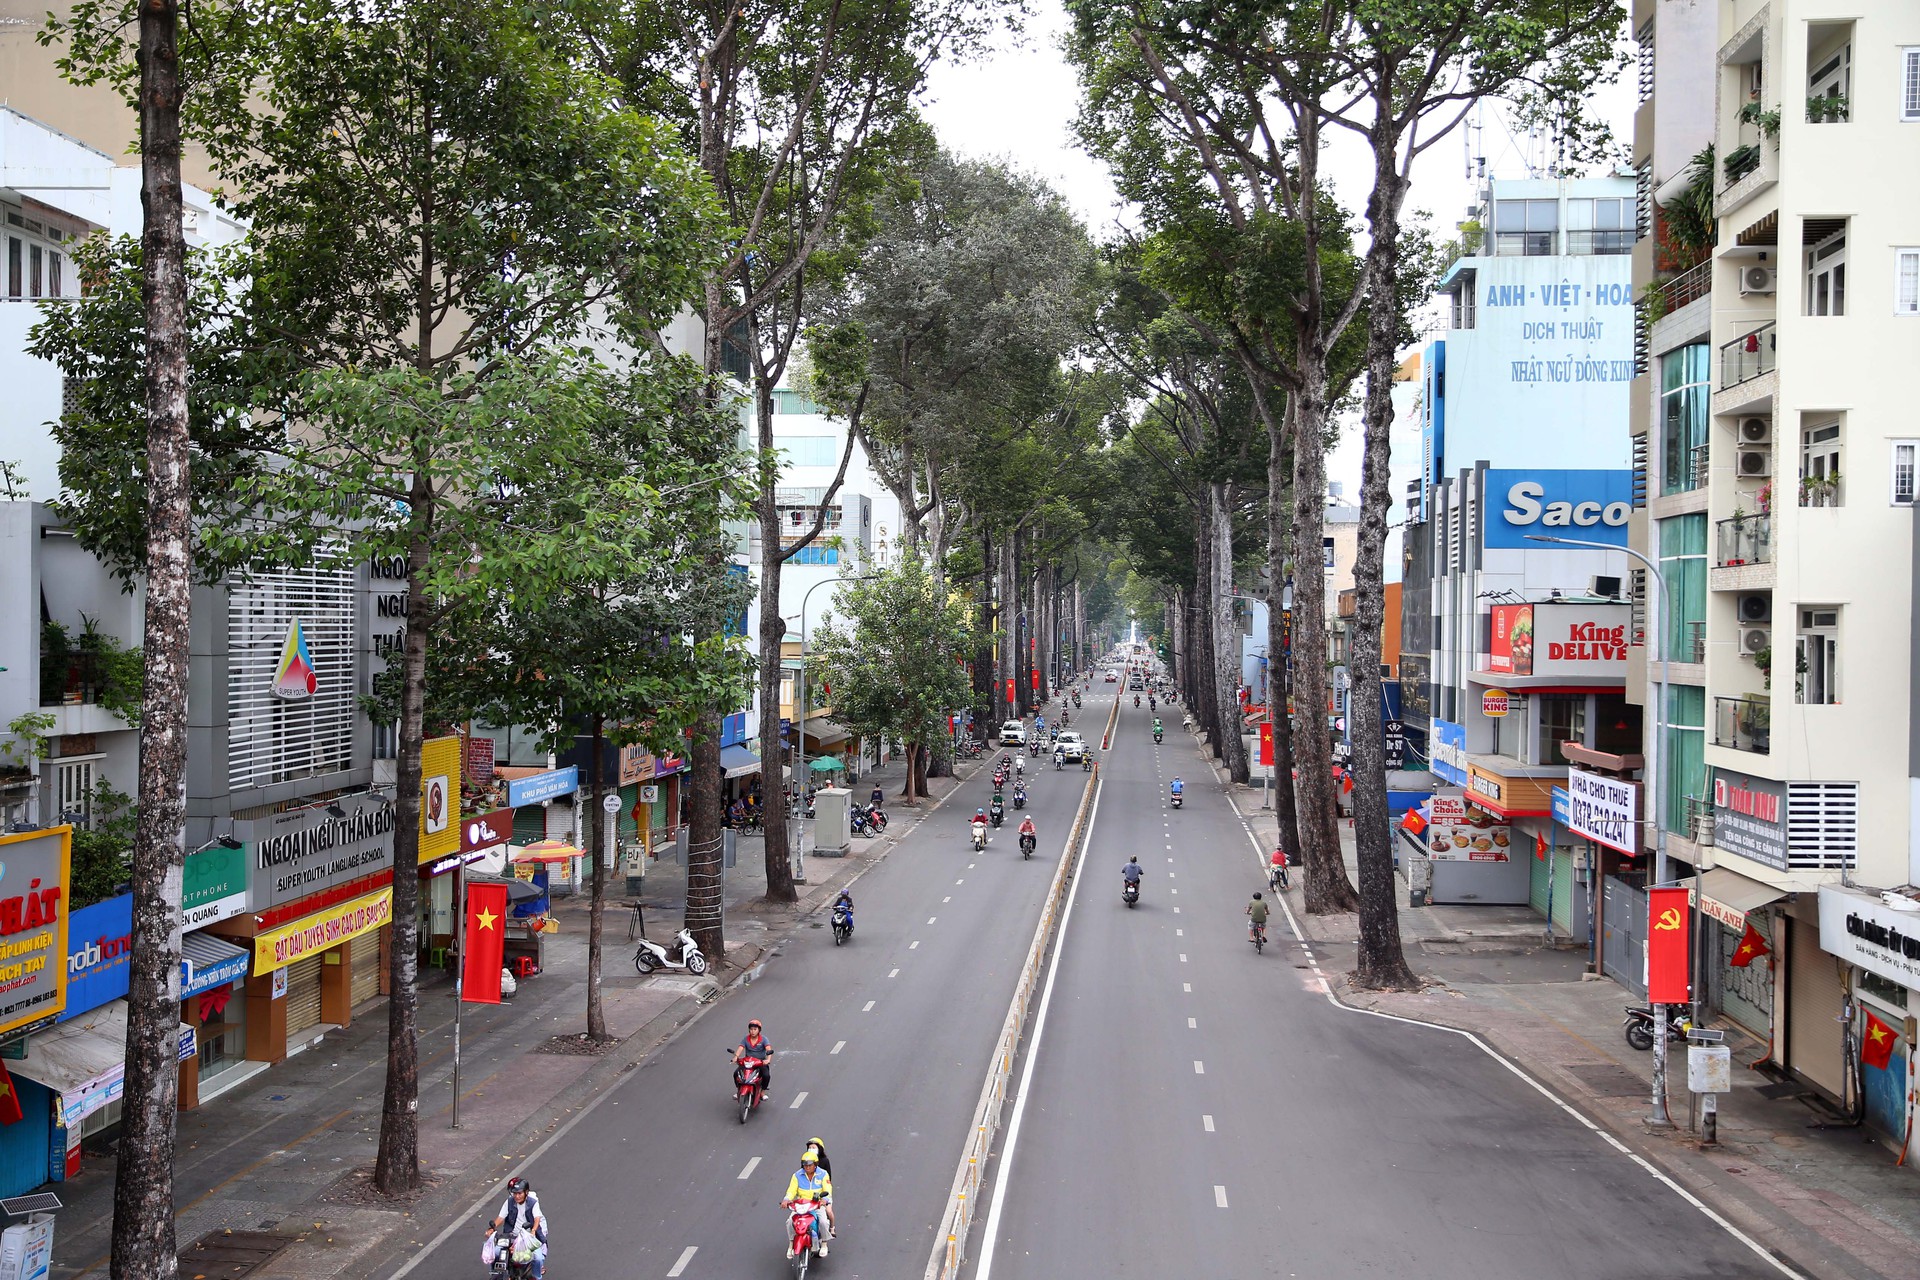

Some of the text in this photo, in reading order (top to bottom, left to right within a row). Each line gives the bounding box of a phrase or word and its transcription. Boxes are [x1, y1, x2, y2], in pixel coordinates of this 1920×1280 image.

[1486, 284, 1526, 306] ANH
[1540, 279, 1580, 312] VIỆT
[1523, 317, 1604, 345] DỊCH THUẬT
[1511, 353, 1543, 388] NHẬT
[1575, 353, 1608, 382] ĐÔNG
[1503, 481, 1630, 527] Saco
[1570, 621, 1625, 647] King
[279, 687, 293, 696] SUPER
[1483, 697, 1508, 705] BURGER
[1483, 703, 1508, 712] KING
[1395, 740, 1403, 750] ST
[521, 789, 535, 800] KHU
[1434, 798, 1458, 809] King's
[1572, 775, 1628, 807] NHÀ CHO THUÊ
[1434, 806, 1463, 814] Choice
[1754, 791, 1780, 823] ANH
[258, 829, 307, 869] NGOẠI
[307, 817, 336, 856] NGỮ
[1743, 834, 1755, 849] CÔNG
[1756, 840, 1763, 851] XE
[277, 847, 384, 892] SUPER YOUTH LANGUAGE SCHOOL
[0, 878, 61, 936] HÁT
[192, 904, 219, 923] QUANG
[1700, 898, 1722, 919] TUẤN
[1722, 911, 1743, 929] ANH
[326, 917, 340, 942] SINH
[366, 905, 379, 925] SAU
[14, 941, 33, 957] LINH
[34, 930, 53, 950] KIỆN
[24, 955, 47, 974] TAY
